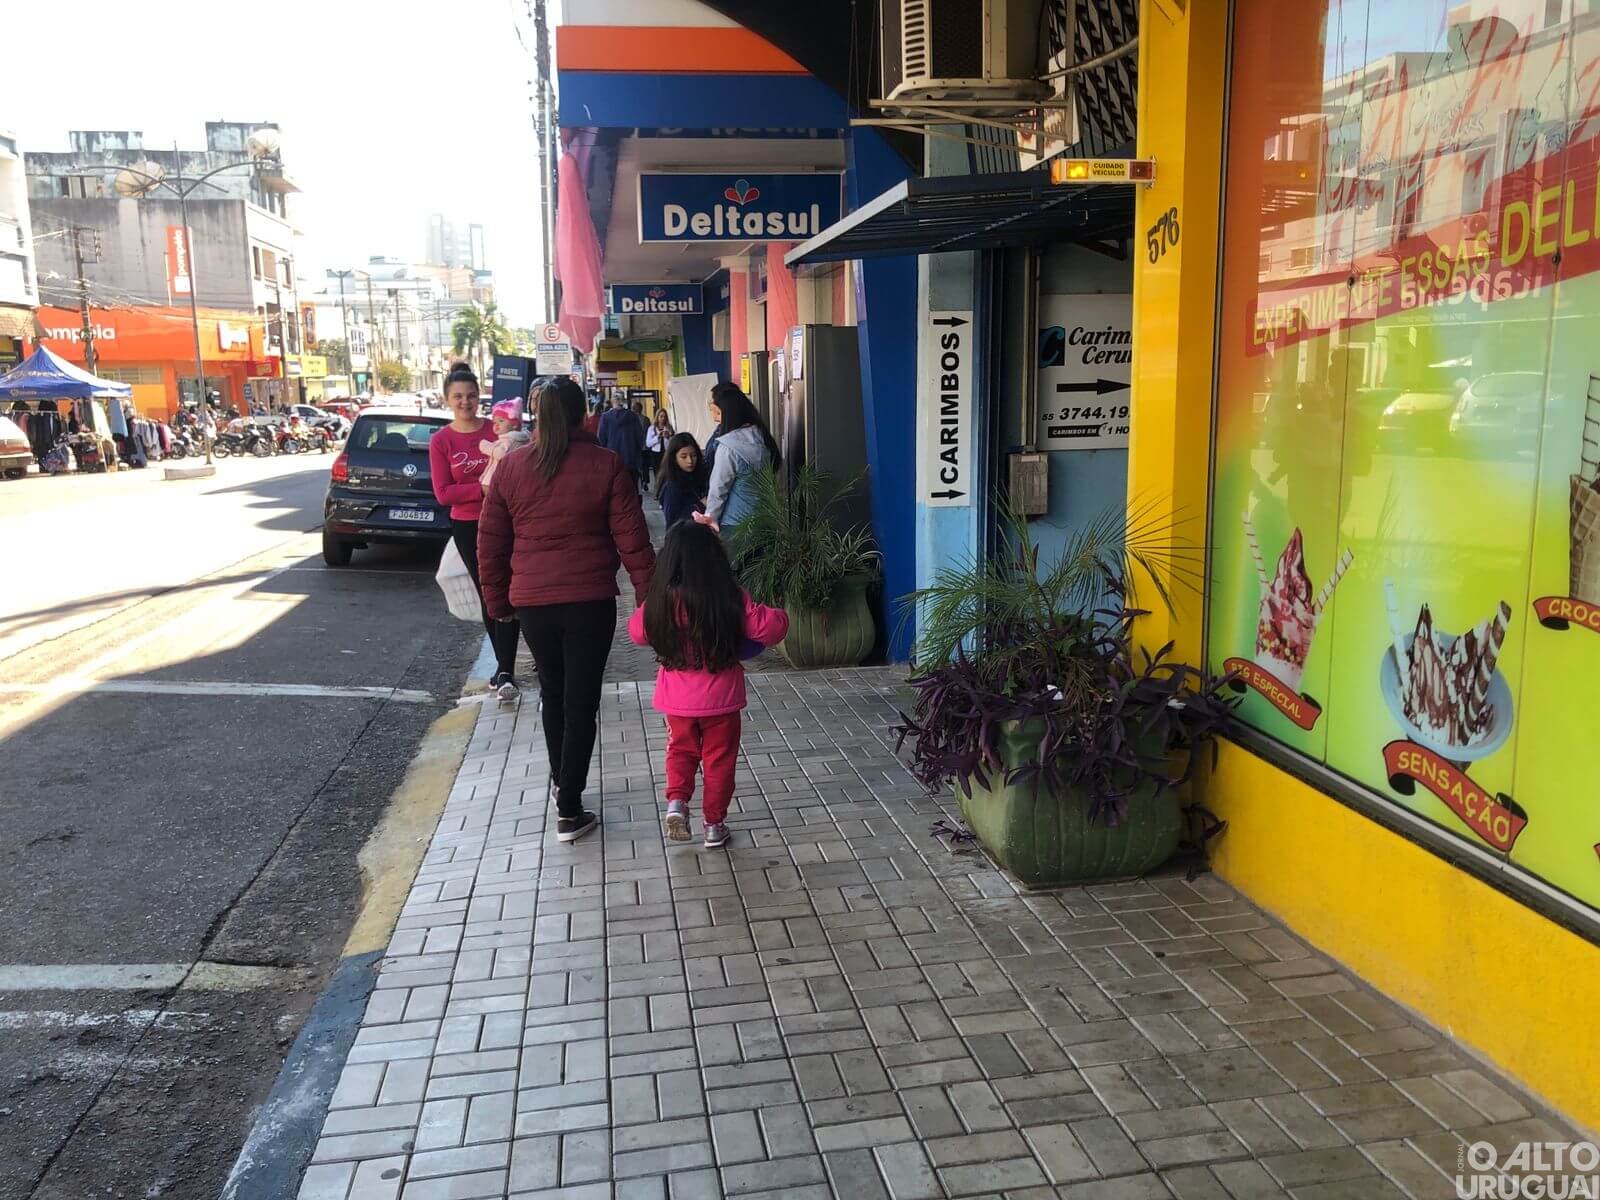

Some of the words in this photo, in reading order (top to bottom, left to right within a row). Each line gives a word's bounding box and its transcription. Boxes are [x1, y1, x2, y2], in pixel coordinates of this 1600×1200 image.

[663, 203, 820, 237] Deltasul
[1147, 206, 1180, 264] 576
[621, 297, 694, 313] Deltasul
[1253, 272, 1393, 345] EXPERIMENTE
[1401, 229, 1491, 300] ESSAS
[1069, 326, 1132, 346] Carim
[940, 332, 960, 485] CARIMBOS
[1042, 413, 1054, 421] 55
[1060, 406, 1130, 420] 3744.19
[1253, 671, 1301, 719] ESPECIAL
[1397, 750, 1511, 844] SENSAÇÃO
